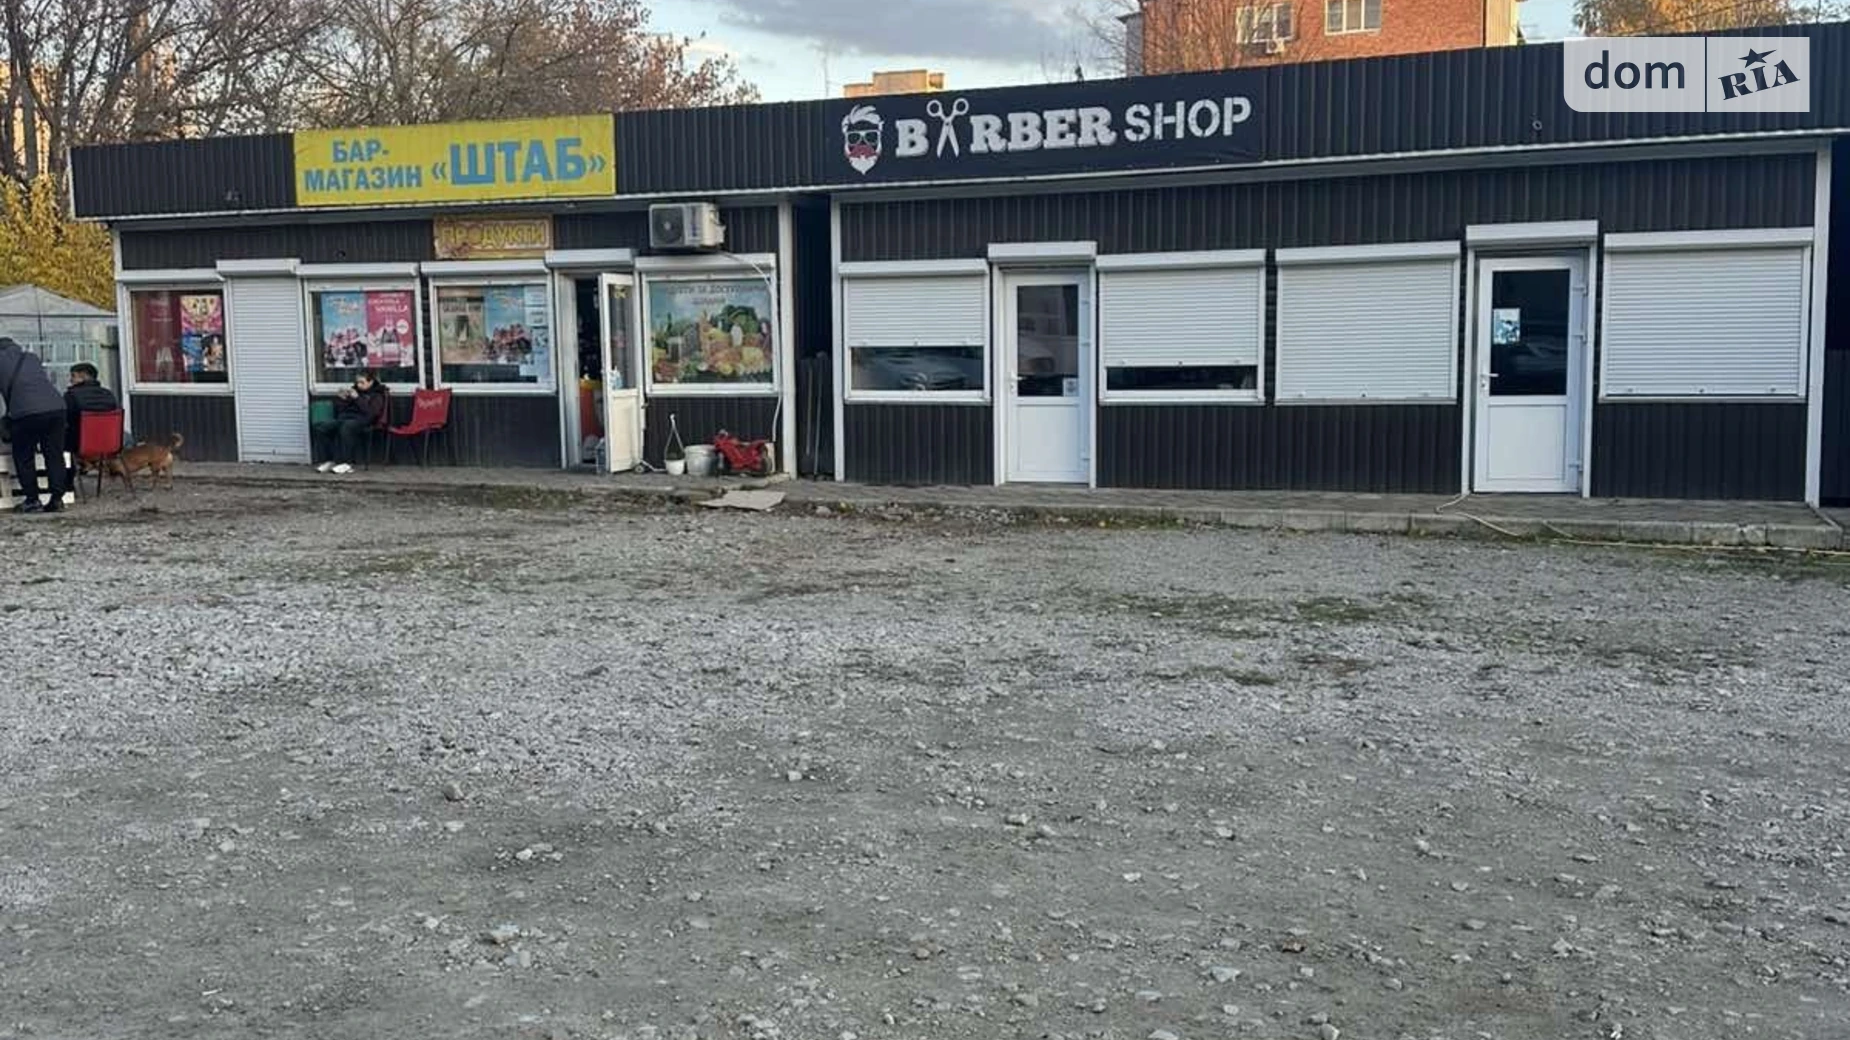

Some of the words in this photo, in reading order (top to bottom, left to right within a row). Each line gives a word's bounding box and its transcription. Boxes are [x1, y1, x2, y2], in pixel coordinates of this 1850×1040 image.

[1124, 97, 1251, 142] SHOP
[304, 165, 422, 192] МАГАЗИН
[432, 137, 605, 186] «ШТАБ»
[332, 139, 389, 164] БАР-
[440, 223, 545, 249] ПРОДУКТИ
